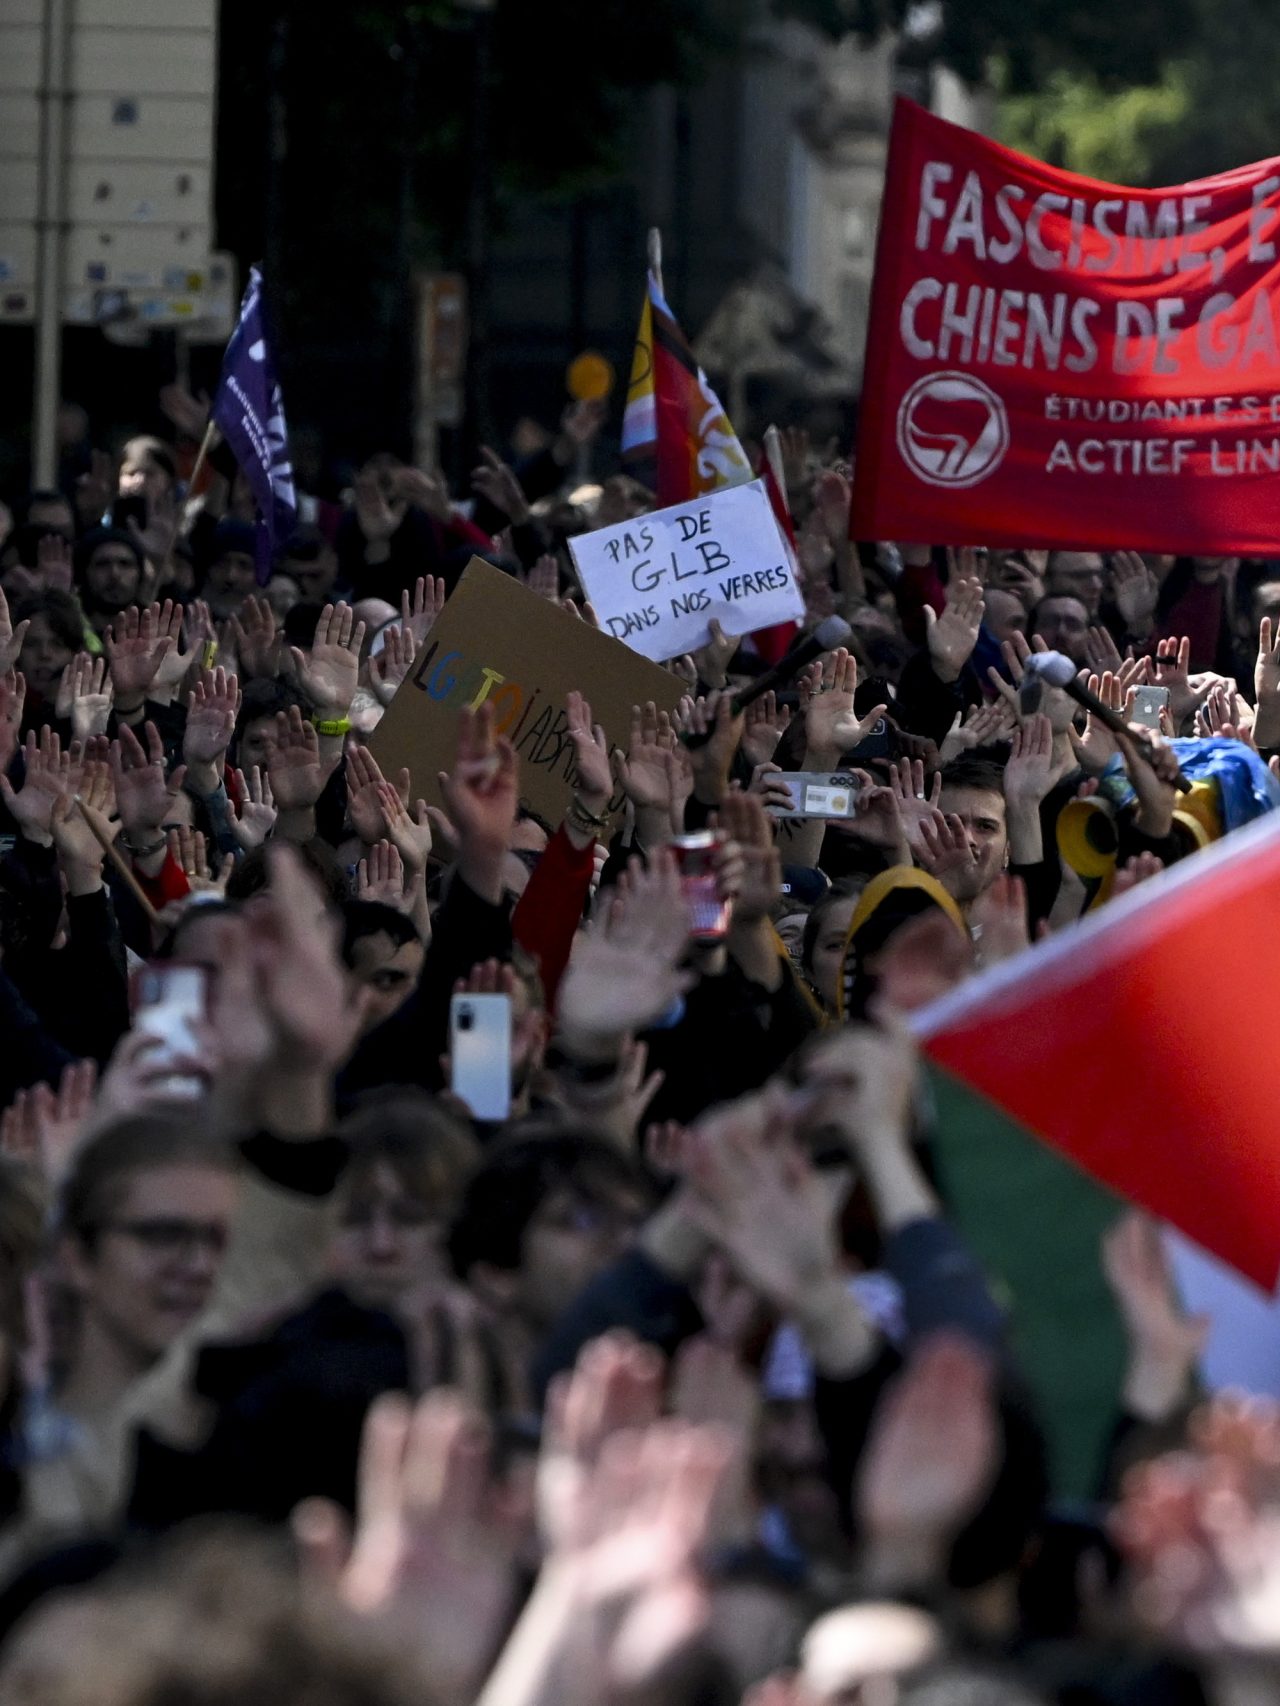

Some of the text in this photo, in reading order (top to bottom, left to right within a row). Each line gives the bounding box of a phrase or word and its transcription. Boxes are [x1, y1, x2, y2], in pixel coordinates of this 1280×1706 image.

[916, 161, 1227, 284] FASCISME,
[899, 277, 1101, 373] CHIENS
[1112, 298, 1185, 375] DE
[1045, 438, 1197, 477] ACTIEF
[603, 510, 712, 564] PAS DE
[606, 565, 788, 639] DANS NOS VERRES
